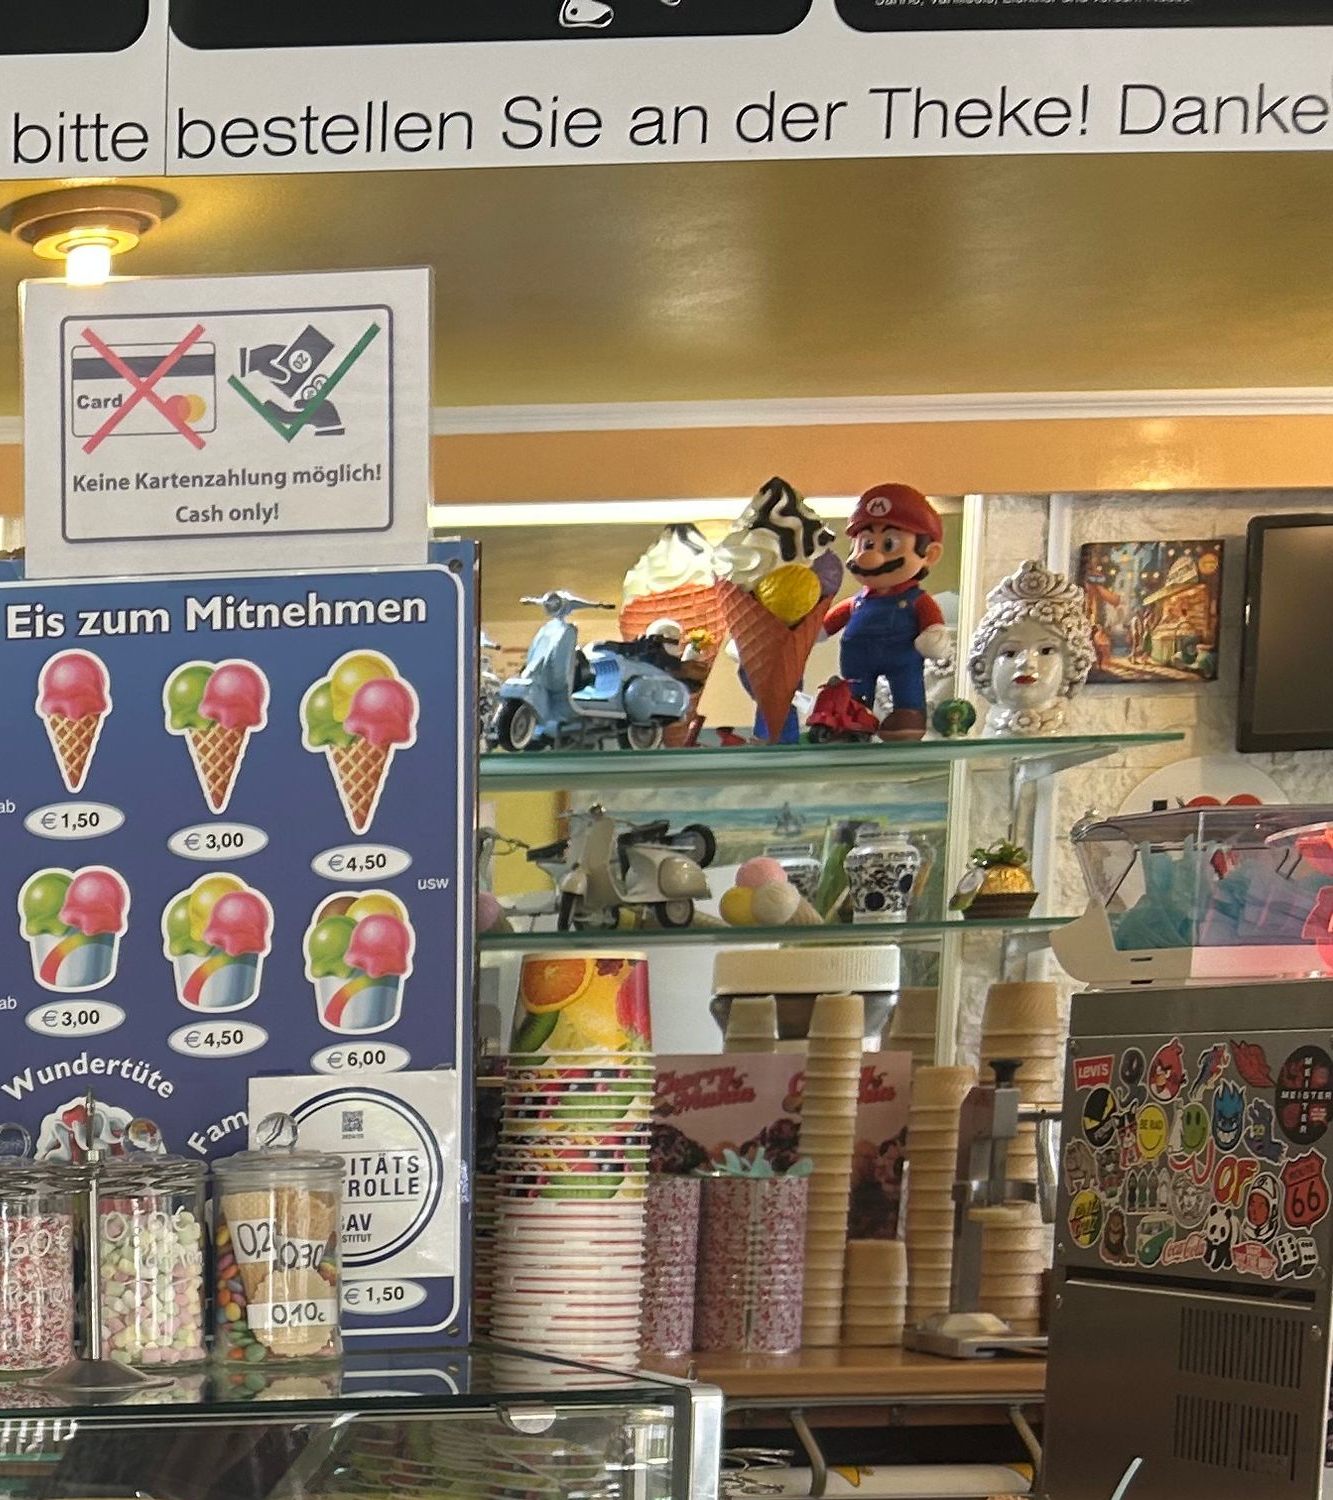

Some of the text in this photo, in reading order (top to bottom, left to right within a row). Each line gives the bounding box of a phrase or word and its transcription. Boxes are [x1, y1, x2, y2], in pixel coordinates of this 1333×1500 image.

[12, 111, 150, 164] bitte
[177, 97, 475, 160] bestellen
[501, 94, 603, 149] Sie
[629, 103, 709, 147] an
[736, 90, 848, 143] der
[869, 83, 1089, 140] Theke!
[76, 393, 123, 410] Card
[73, 464, 382, 493] Keine Kartenzahlung möglich!
[175, 502, 279, 525] Cash only!
[5, 593, 428, 640] Eis zum Mitnehmen
[40, 811, 100, 832] € 1,50
[183, 831, 245, 852] € 3,00
[327, 852, 387, 873] € 4,50
[416, 877, 450, 891] usw
[40, 1008, 100, 1029] € 3,00
[183, 1029, 245, 1050] € 4,50
[326, 1049, 387, 1069] € 6,00
[0, 1051, 176, 1103] Wundertüte
[341, 1177, 420, 1198] ROLLE
[1291, 1180, 1321, 1218] 66
[341, 1213, 373, 1232] AV
[344, 1286, 405, 1305] € 1,50
